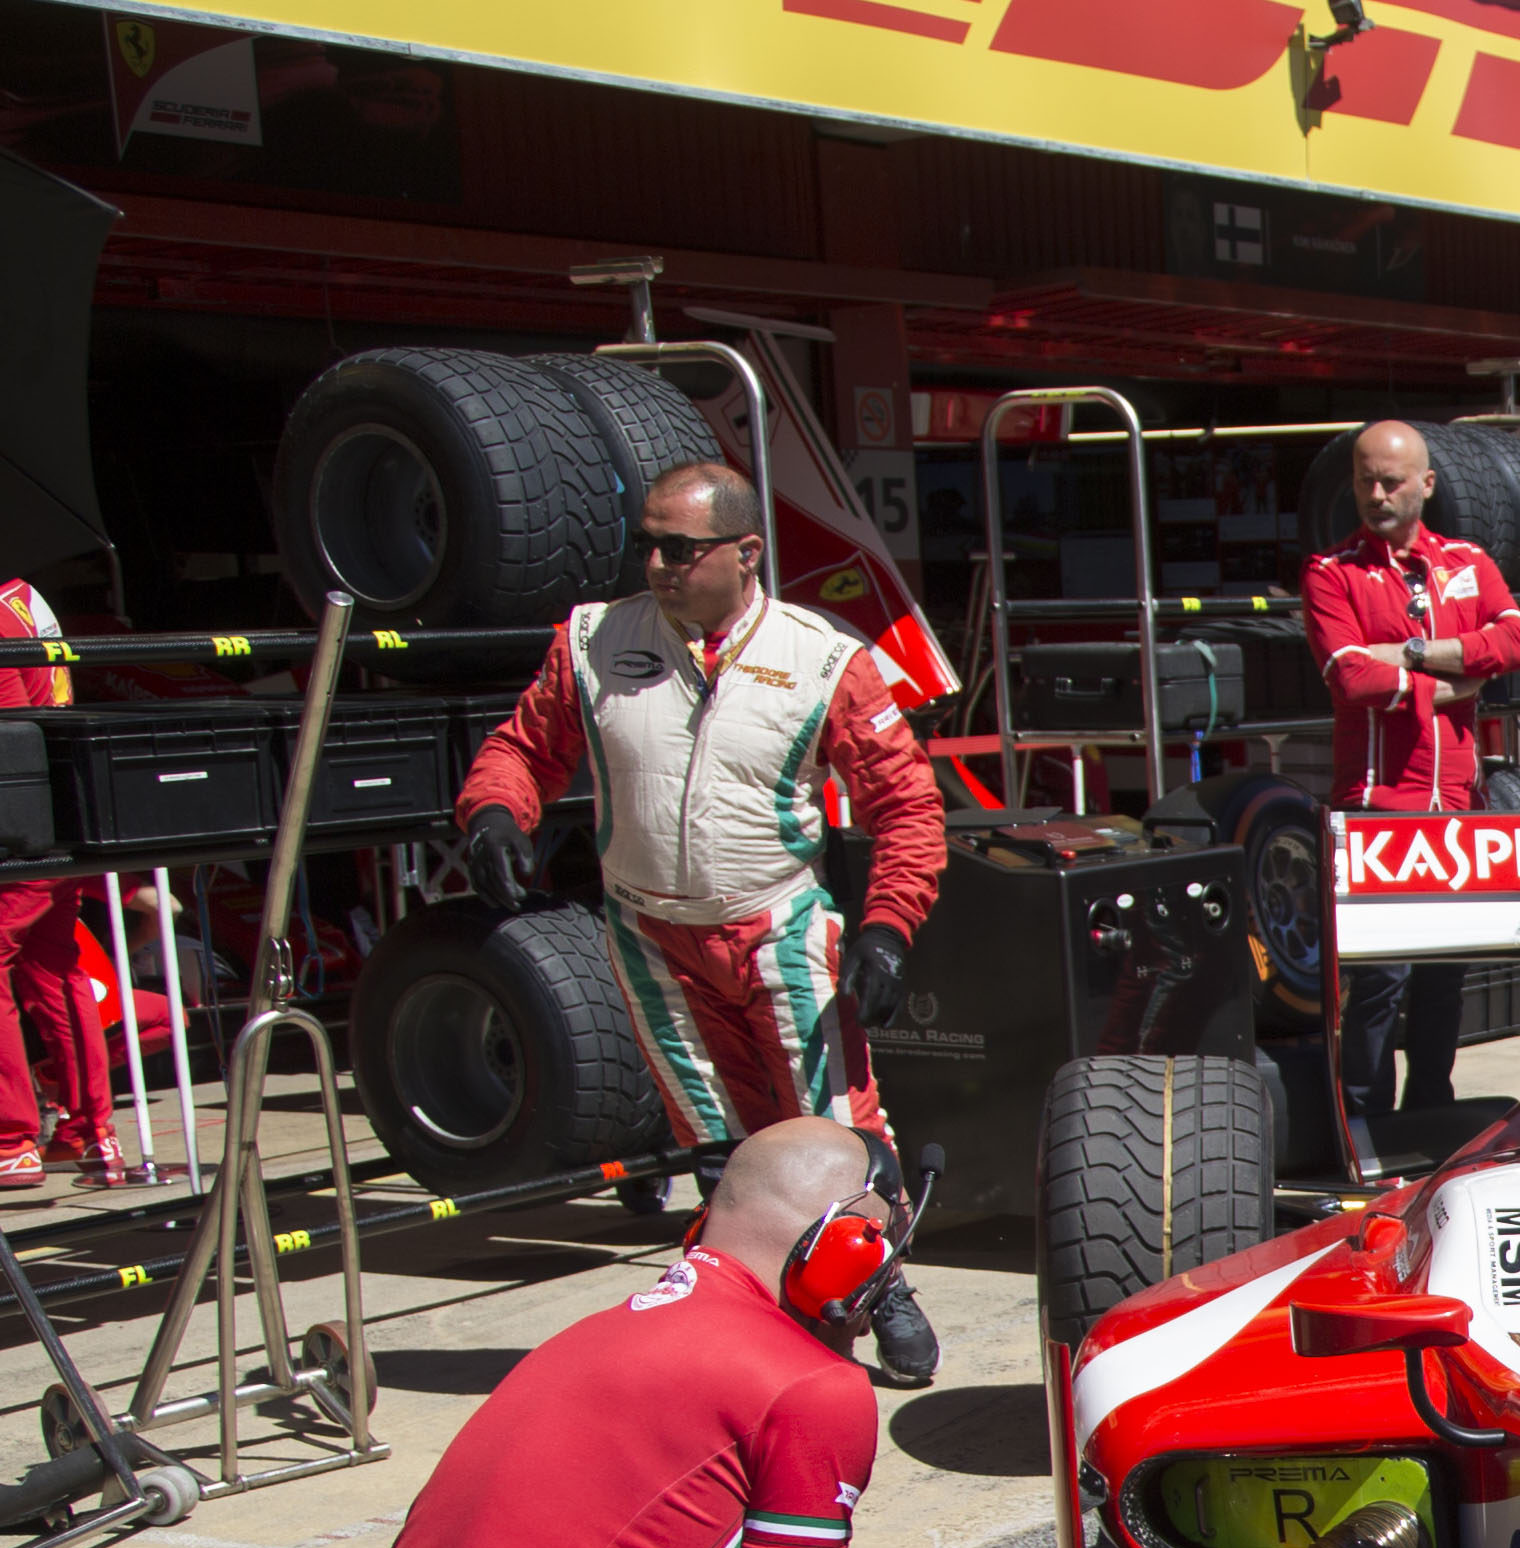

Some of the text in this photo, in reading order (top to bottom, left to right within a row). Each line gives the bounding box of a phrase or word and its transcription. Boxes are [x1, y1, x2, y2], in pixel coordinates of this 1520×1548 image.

[211, 636, 251, 656] RR
[371, 630, 409, 649] RL
[42, 640, 81, 662] FL
[734, 663, 793, 680] THEODORE
[753, 674, 798, 691] RACING
[925, 1029, 985, 1045] RACING
[429, 1198, 462, 1221] RL
[273, 1230, 311, 1254] RR
[118, 1265, 153, 1289] FL
[1230, 1466, 1352, 1483] PREMA
[1273, 1488, 1320, 1544] R
